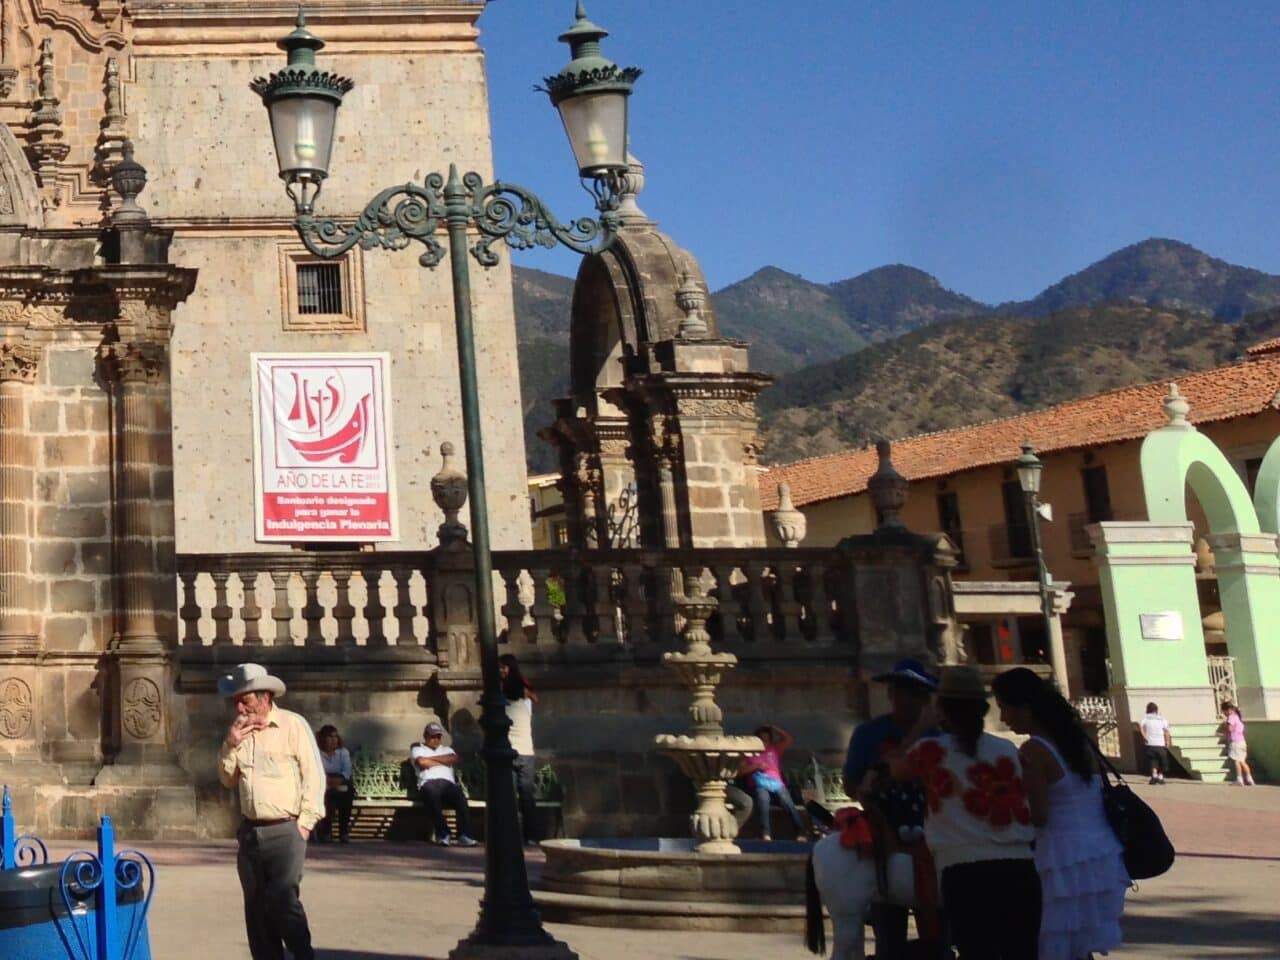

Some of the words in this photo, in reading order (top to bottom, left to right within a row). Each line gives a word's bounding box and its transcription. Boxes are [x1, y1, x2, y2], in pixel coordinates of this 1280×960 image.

[277, 470, 308, 488] AÑO
[311, 473, 328, 488] DE
[332, 473, 348, 488] LA
[351, 473, 365, 488] FE
[277, 496, 325, 505] Santuario
[294, 509, 318, 517] para
[266, 519, 337, 531] Indulgencia
[340, 519, 389, 529] Plenaria
